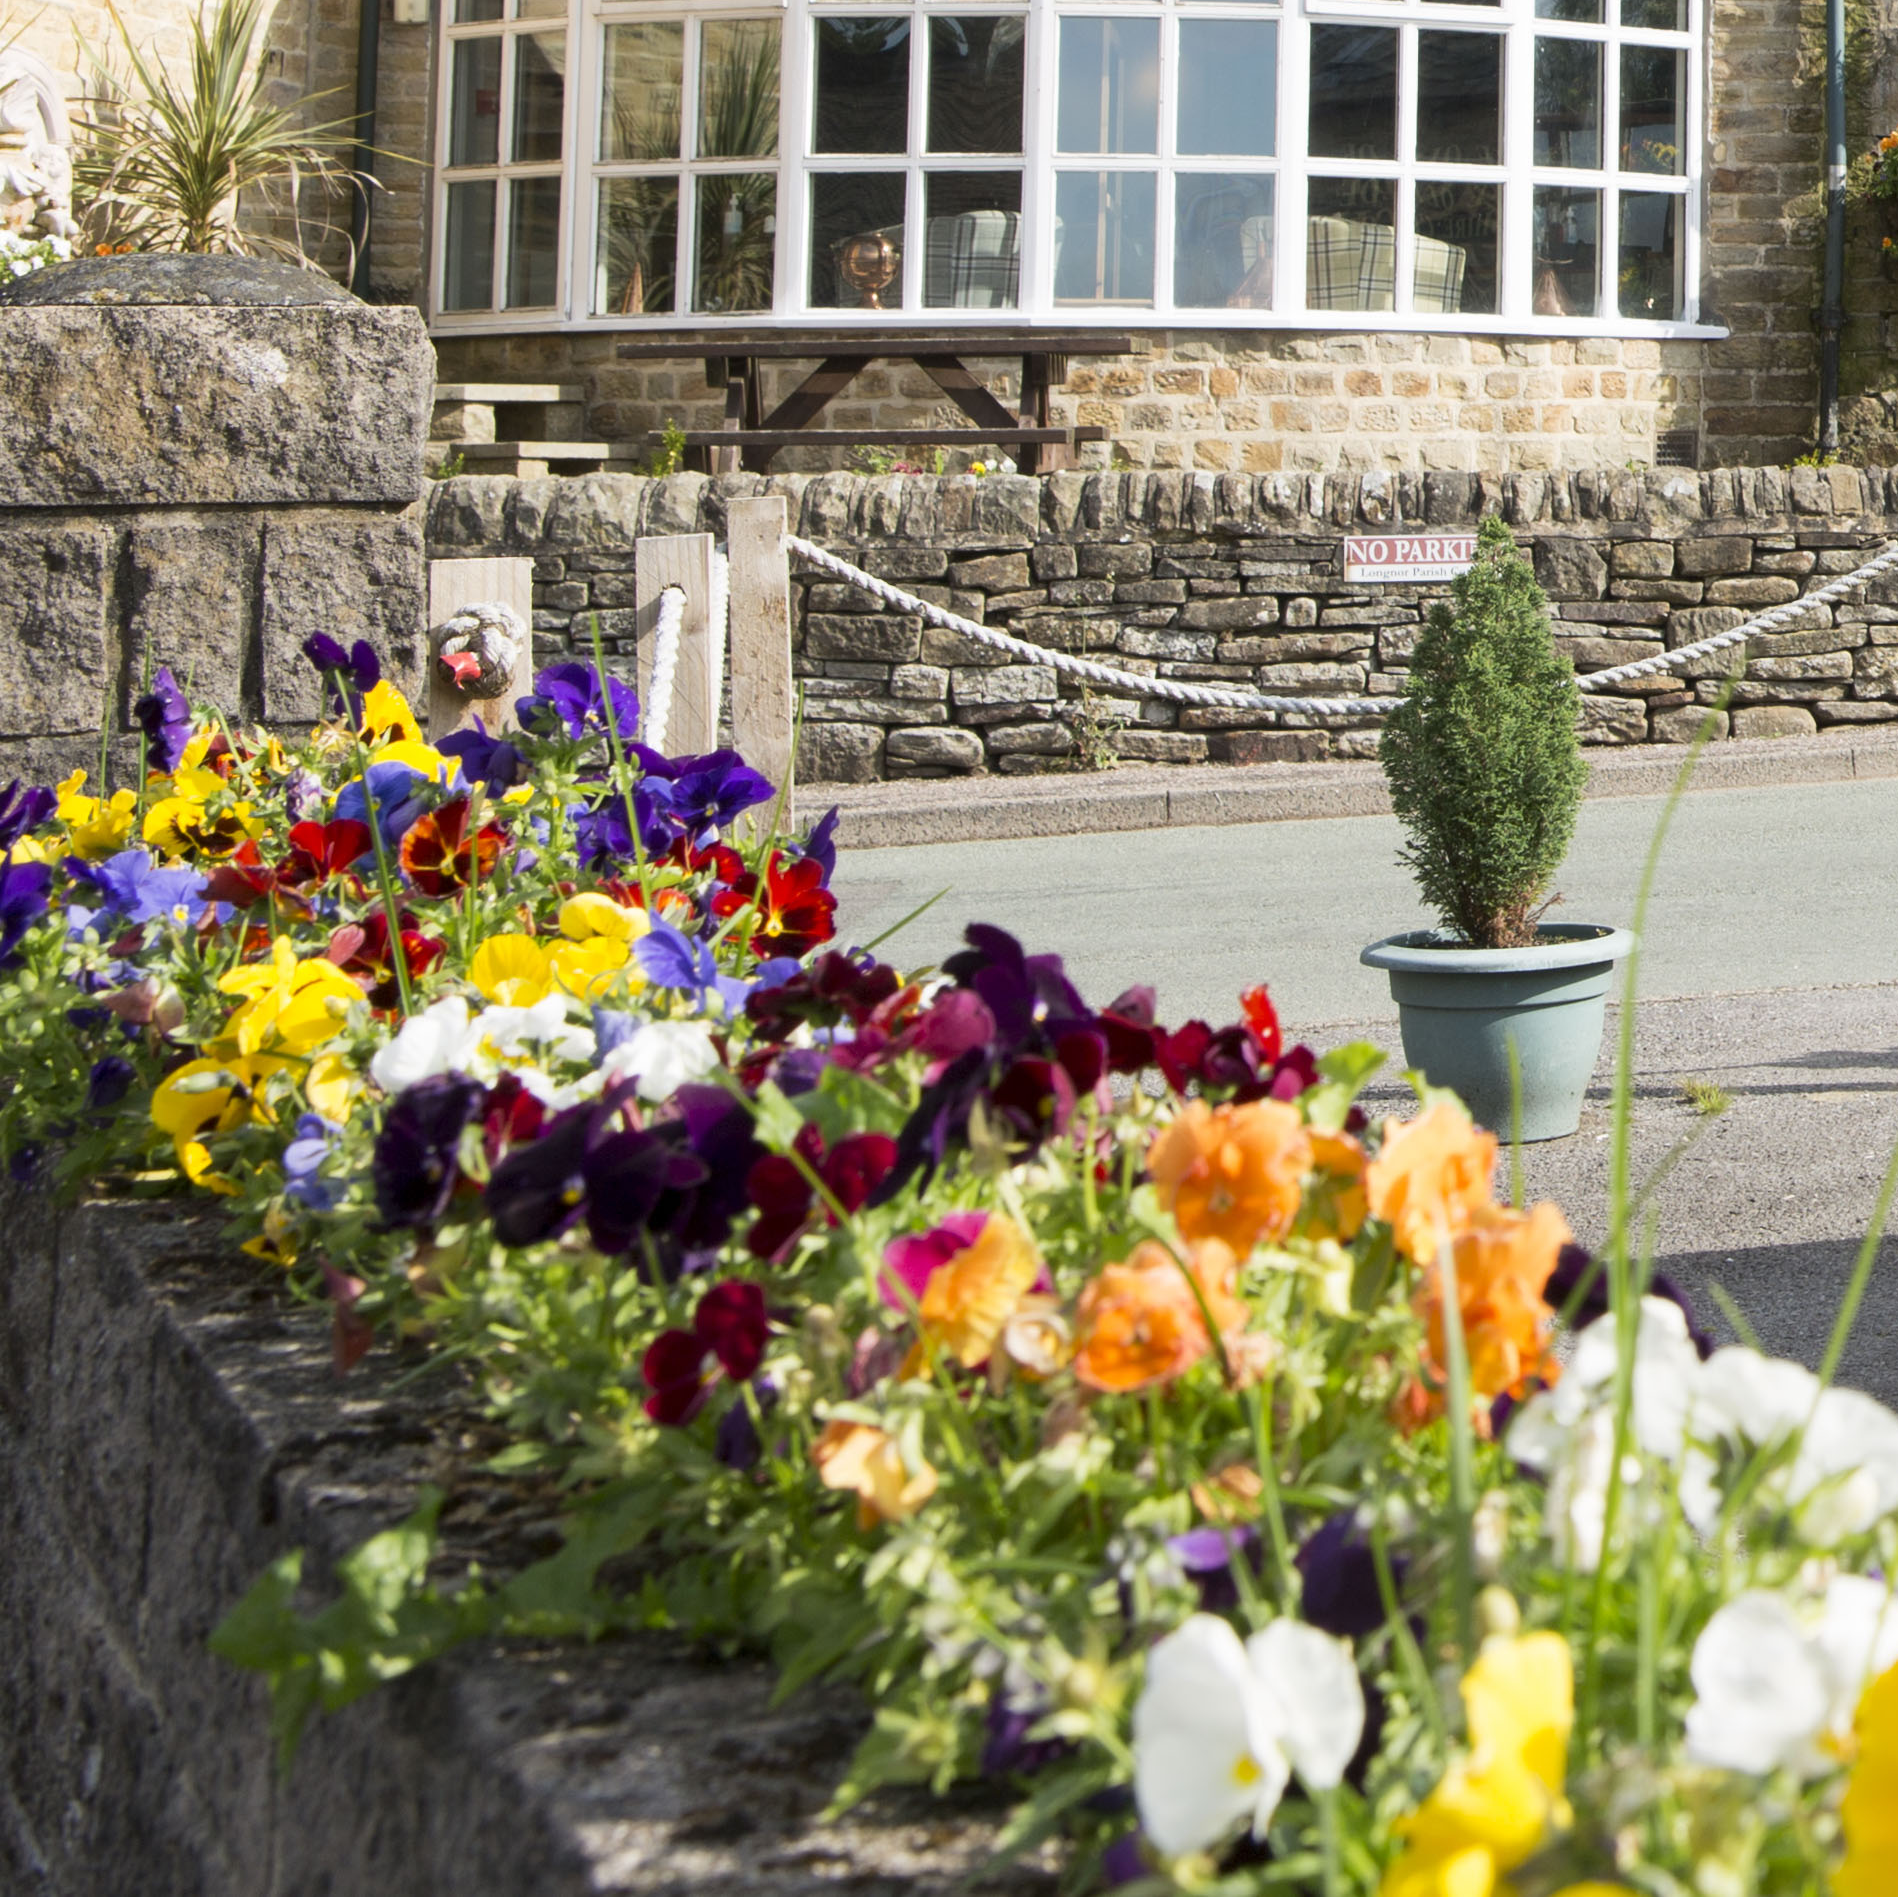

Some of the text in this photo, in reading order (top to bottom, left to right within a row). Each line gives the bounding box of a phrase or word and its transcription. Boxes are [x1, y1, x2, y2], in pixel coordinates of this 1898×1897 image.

[1348, 539, 1477, 563] NO PARKI
[1413, 567, 1446, 577] Parish
